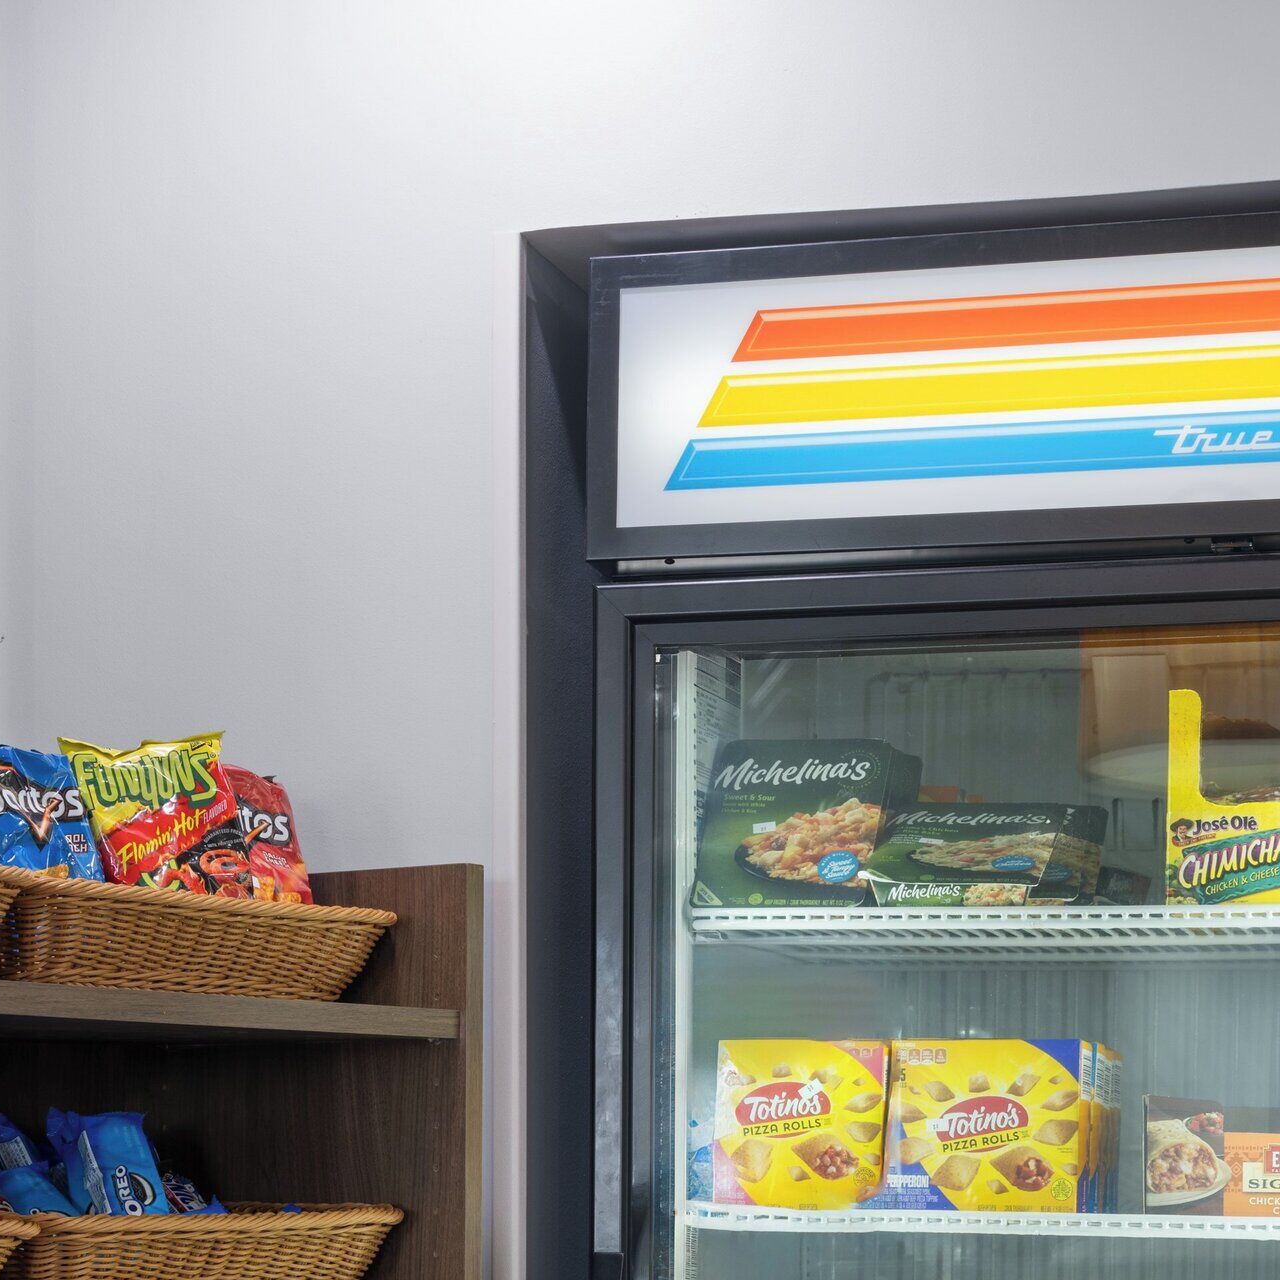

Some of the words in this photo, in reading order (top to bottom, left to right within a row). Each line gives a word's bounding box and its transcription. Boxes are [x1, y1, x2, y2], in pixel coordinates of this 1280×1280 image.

[72, 752, 212, 810] FUNYUNS
[714, 758, 871, 791] Michelina's
[120, 824, 172, 871] Flamin'
[173, 807, 205, 840] Hot
[1192, 816, 1230, 836] José
[1230, 814, 1258, 830] Olé
[888, 883, 961, 900] Michelina's
[1206, 879, 1239, 896] CHICKEN
[1241, 876, 1248, 886] &
[1249, 868, 1280, 882] CHEESE
[745, 1091, 820, 1120] Totino's
[743, 1123, 780, 1137] PIZZA
[783, 1118, 821, 1131] ROLLS
[115, 1165, 143, 1216] OREO
